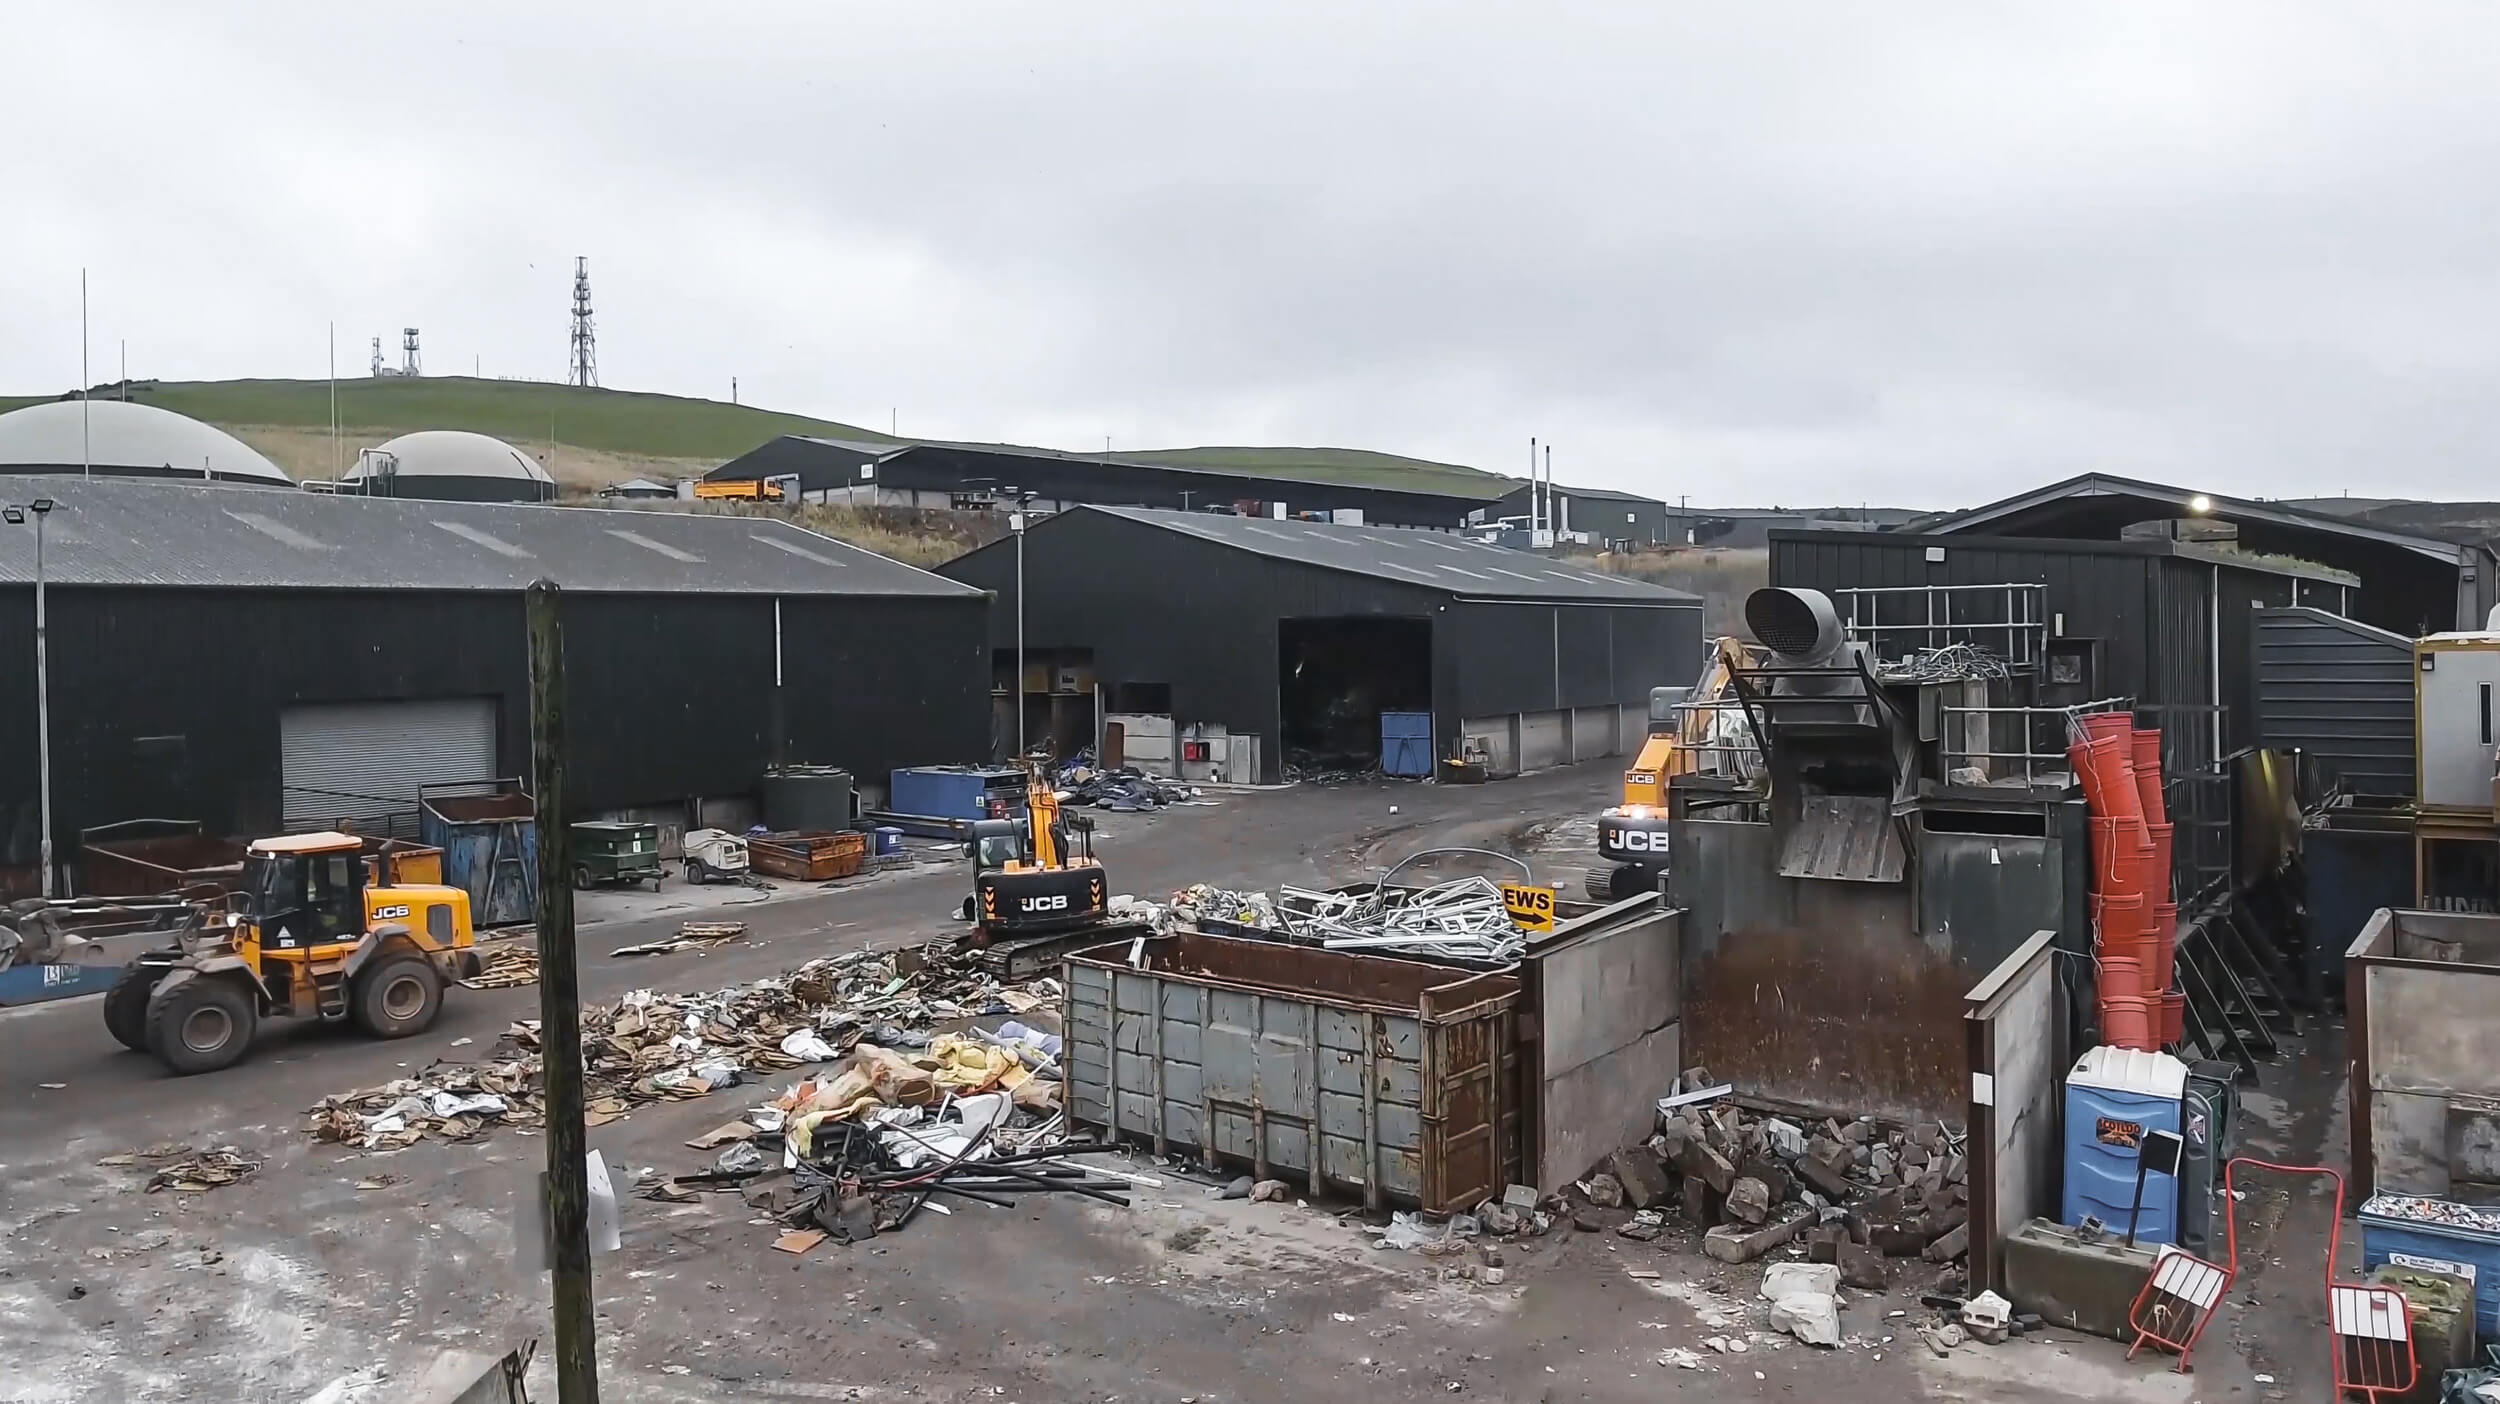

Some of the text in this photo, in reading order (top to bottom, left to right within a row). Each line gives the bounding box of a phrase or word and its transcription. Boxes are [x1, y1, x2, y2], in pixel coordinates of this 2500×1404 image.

[1626, 774, 1655, 784] JCB
[1609, 829, 1669, 852] JCB
[1021, 895, 1068, 912] JCB
[1503, 888, 1550, 910] EWS
[371, 905, 409, 920] JCB
